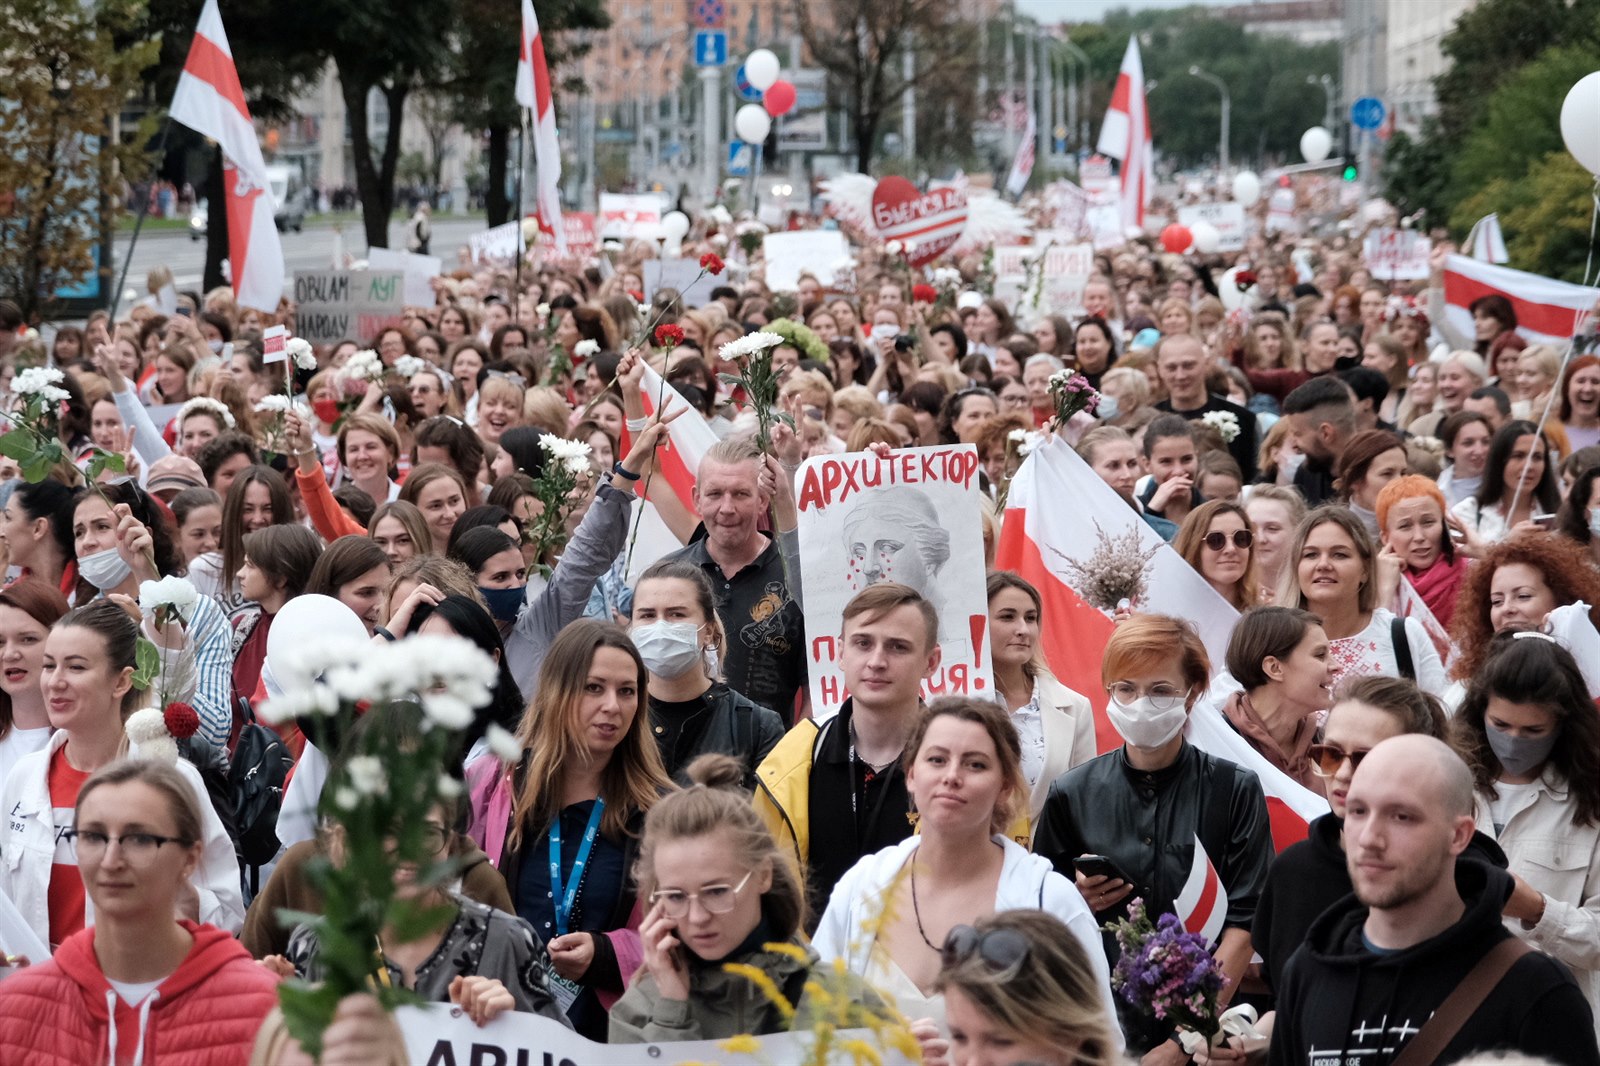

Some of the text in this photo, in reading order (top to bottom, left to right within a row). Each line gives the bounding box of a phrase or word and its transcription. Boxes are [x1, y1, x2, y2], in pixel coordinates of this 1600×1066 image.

[295, 275, 349, 304] ОВЦАМ
[296, 314, 350, 339] НАРОДУ
[798, 451, 979, 512] АРХИТЕКТОР
